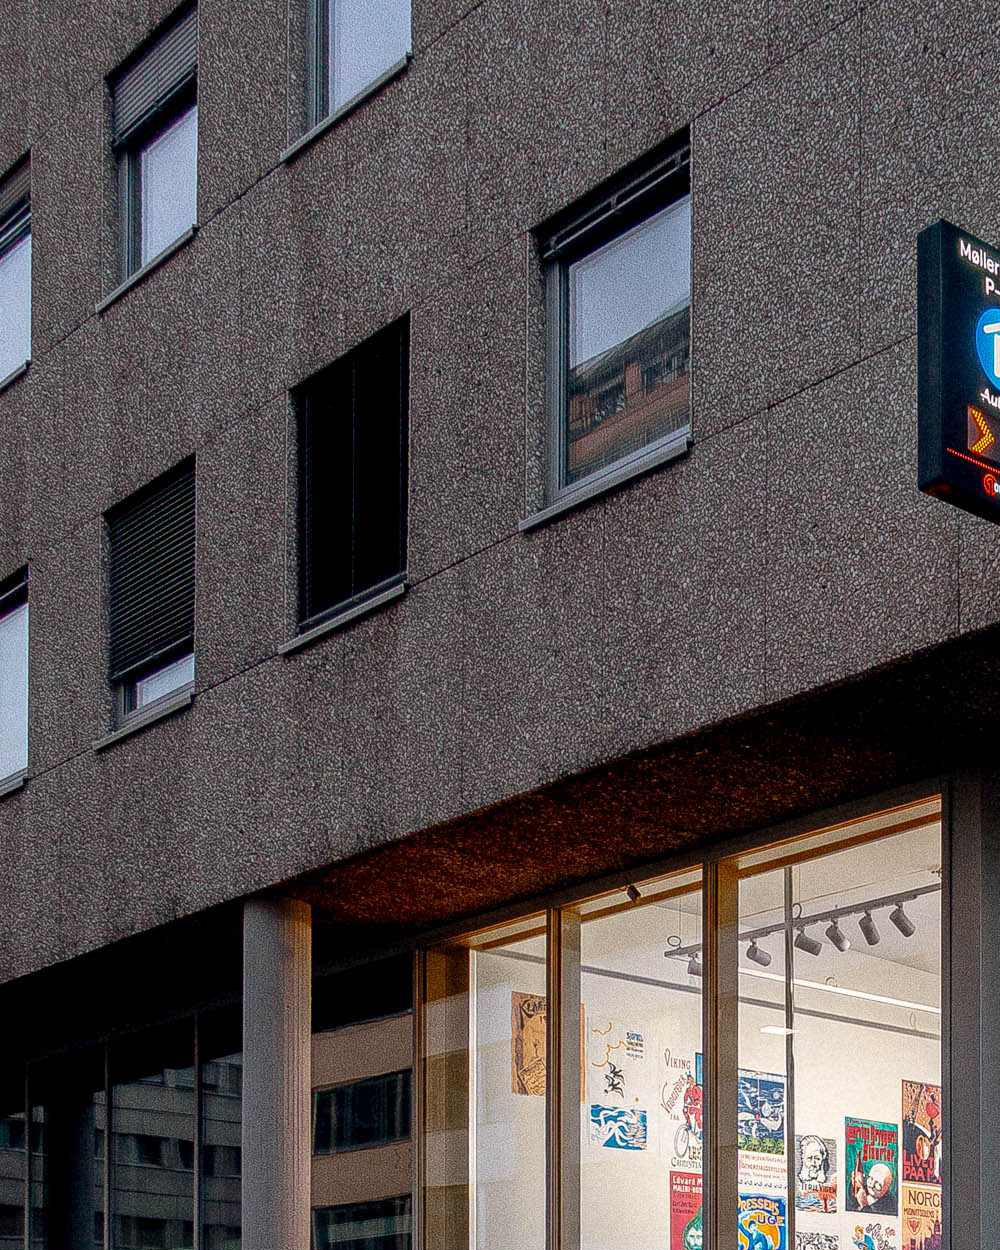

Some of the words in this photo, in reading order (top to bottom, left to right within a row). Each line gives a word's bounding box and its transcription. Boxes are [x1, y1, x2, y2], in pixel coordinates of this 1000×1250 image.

[664, 1048, 691, 1070] VIKING
[903, 1149, 935, 1169] LIVET
[903, 1166, 926, 1182] PAA
[908, 1190, 942, 1208] NORG
[757, 1215, 785, 1227] UGE
